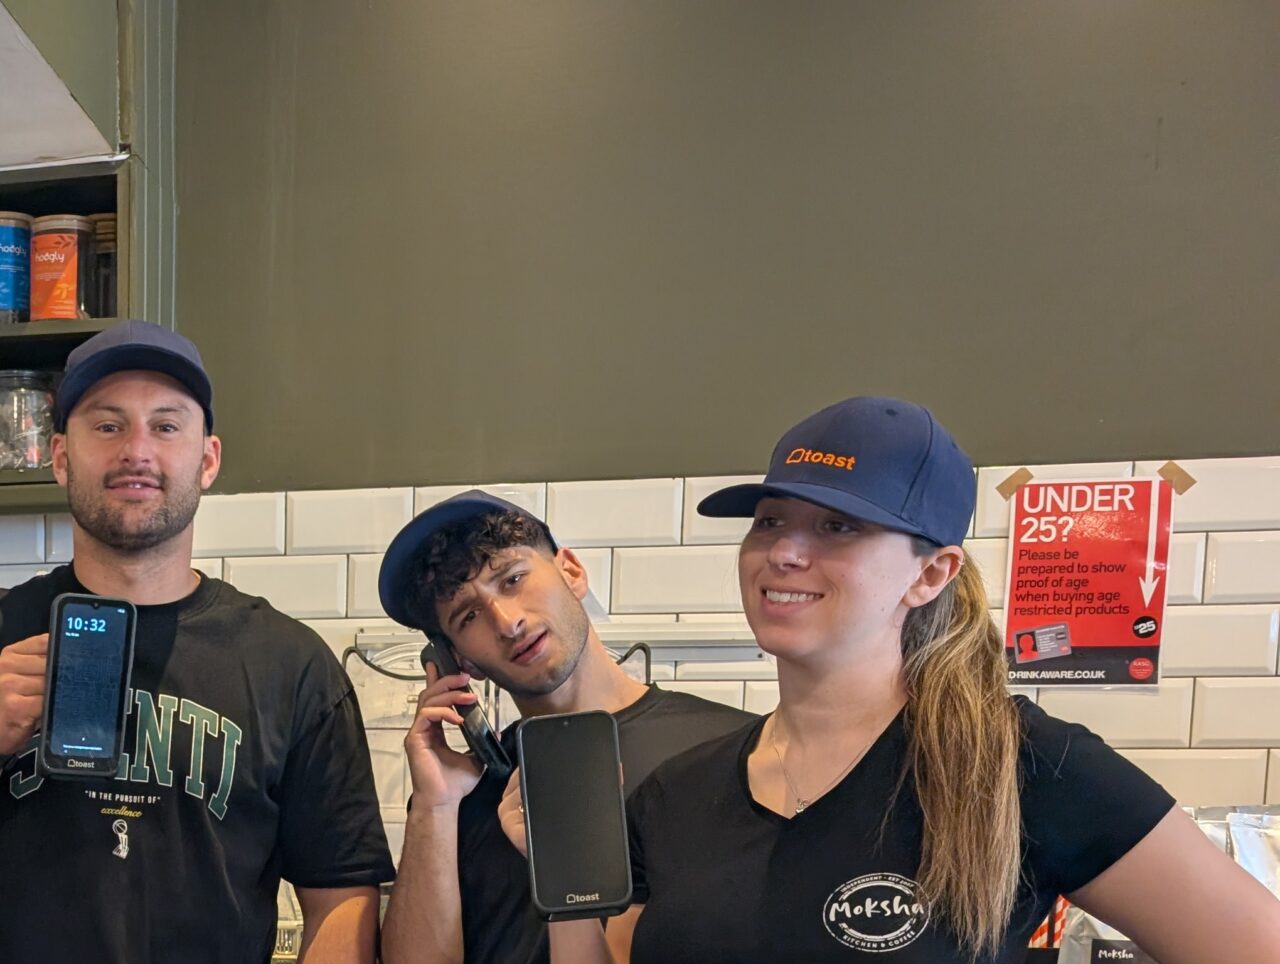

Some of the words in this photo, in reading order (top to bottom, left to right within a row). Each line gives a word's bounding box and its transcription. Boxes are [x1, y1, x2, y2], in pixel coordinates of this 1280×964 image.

[804, 449, 856, 471] toast
[1023, 484, 1136, 514] UNDER
[1020, 516, 1074, 544] 25?
[1019, 549, 1061, 561] Please
[1064, 548, 1080, 560] be
[1017, 562, 1074, 577] prepared
[1077, 563, 1089, 573] to
[1091, 562, 1127, 573] show
[1016, 576, 1050, 591] proof
[1051, 576, 1065, 588] of
[1065, 578, 1089, 590] age
[1015, 591, 1050, 602] when
[1053, 591, 1094, 604] buying
[1097, 592, 1121, 603] age
[1014, 604, 1072, 616] restricted
[1075, 604, 1130, 618] products
[67, 617, 107, 633] 10:32
[75, 760, 95, 768] toast
[99, 792, 112, 801] THE
[115, 793, 145, 803] PURSUIT
[100, 805, 143, 817] excellence
[576, 893, 600, 902] toast
[829, 895, 924, 922] Moksha
[842, 934, 878, 948] KITCHEN
[888, 931, 916, 946] COFFEE
[1098, 949, 1134, 959] Moksha
